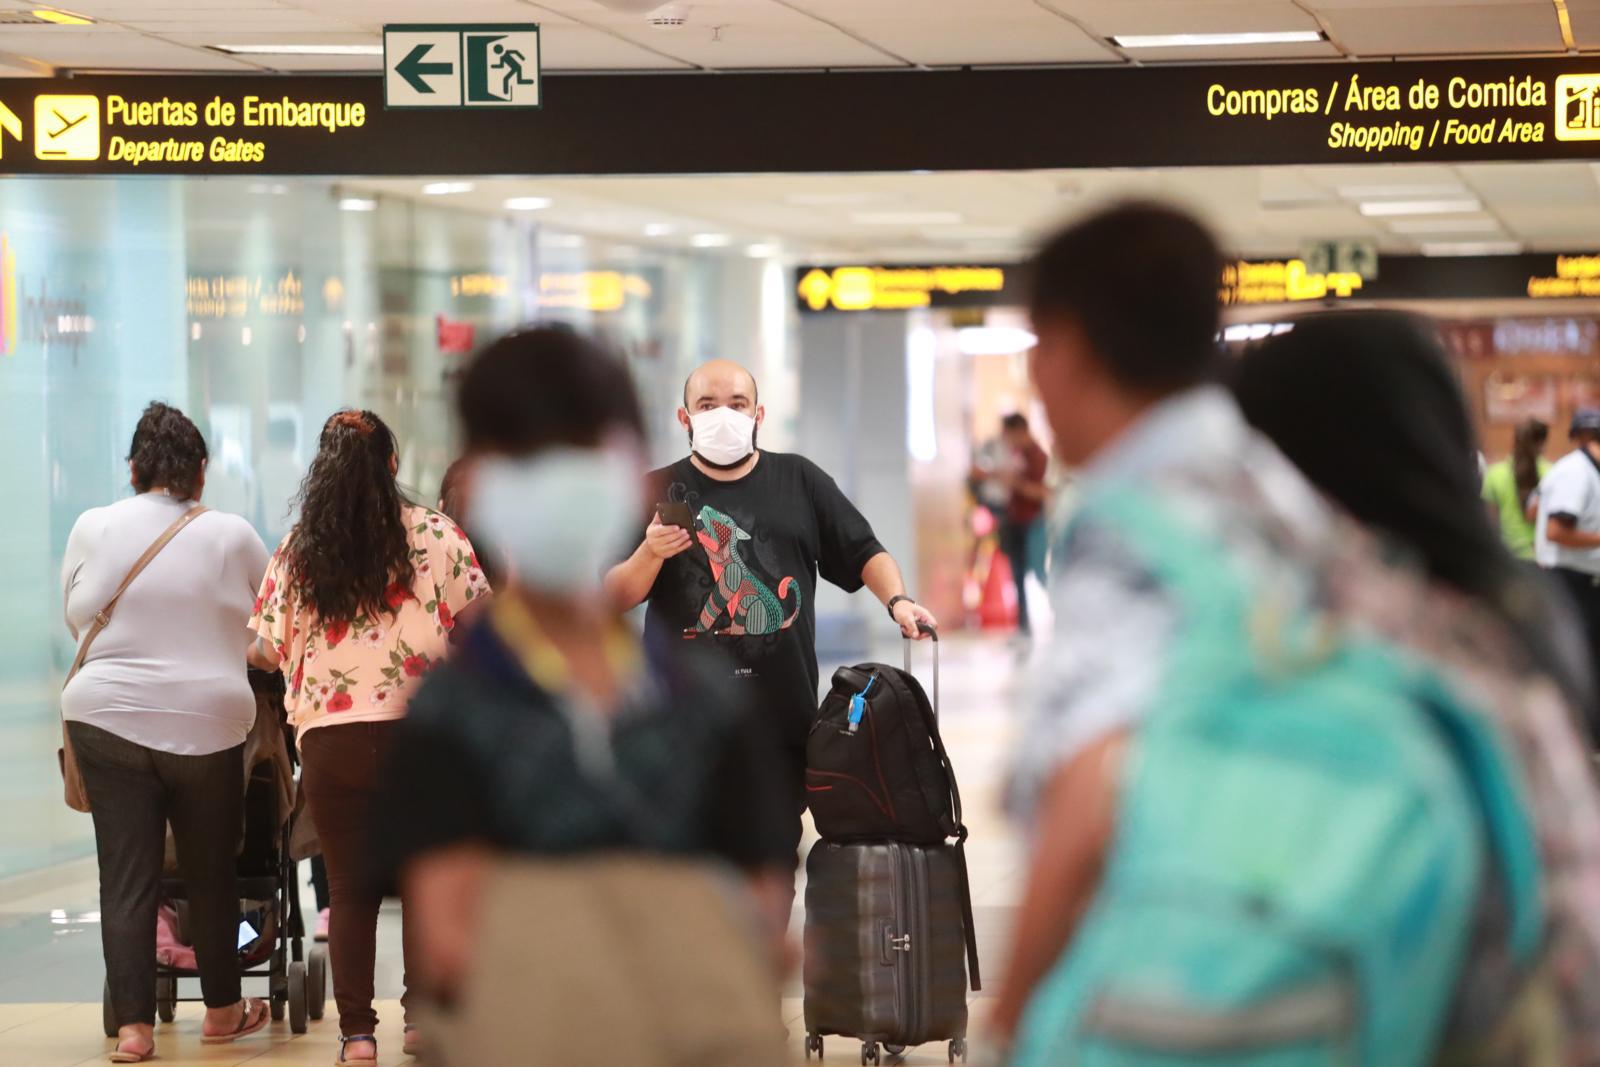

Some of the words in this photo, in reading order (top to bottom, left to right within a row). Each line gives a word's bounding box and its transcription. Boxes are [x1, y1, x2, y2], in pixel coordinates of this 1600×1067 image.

[107, 96, 198, 126] Puertas
[205, 96, 235, 126] de
[243, 96, 366, 133] Embarque
[1207, 84, 1319, 119] Compras
[1325, 81, 1338, 115] /
[1346, 75, 1400, 111] Área
[1409, 79, 1439, 109] de
[1448, 75, 1547, 108] Comida
[108, 137, 204, 165] Departure
[209, 136, 265, 162] Gates
[1328, 121, 1424, 152] Shopping
[1429, 120, 1440, 147] /
[1444, 119, 1495, 145] Food
[1498, 118, 1545, 143] Area
